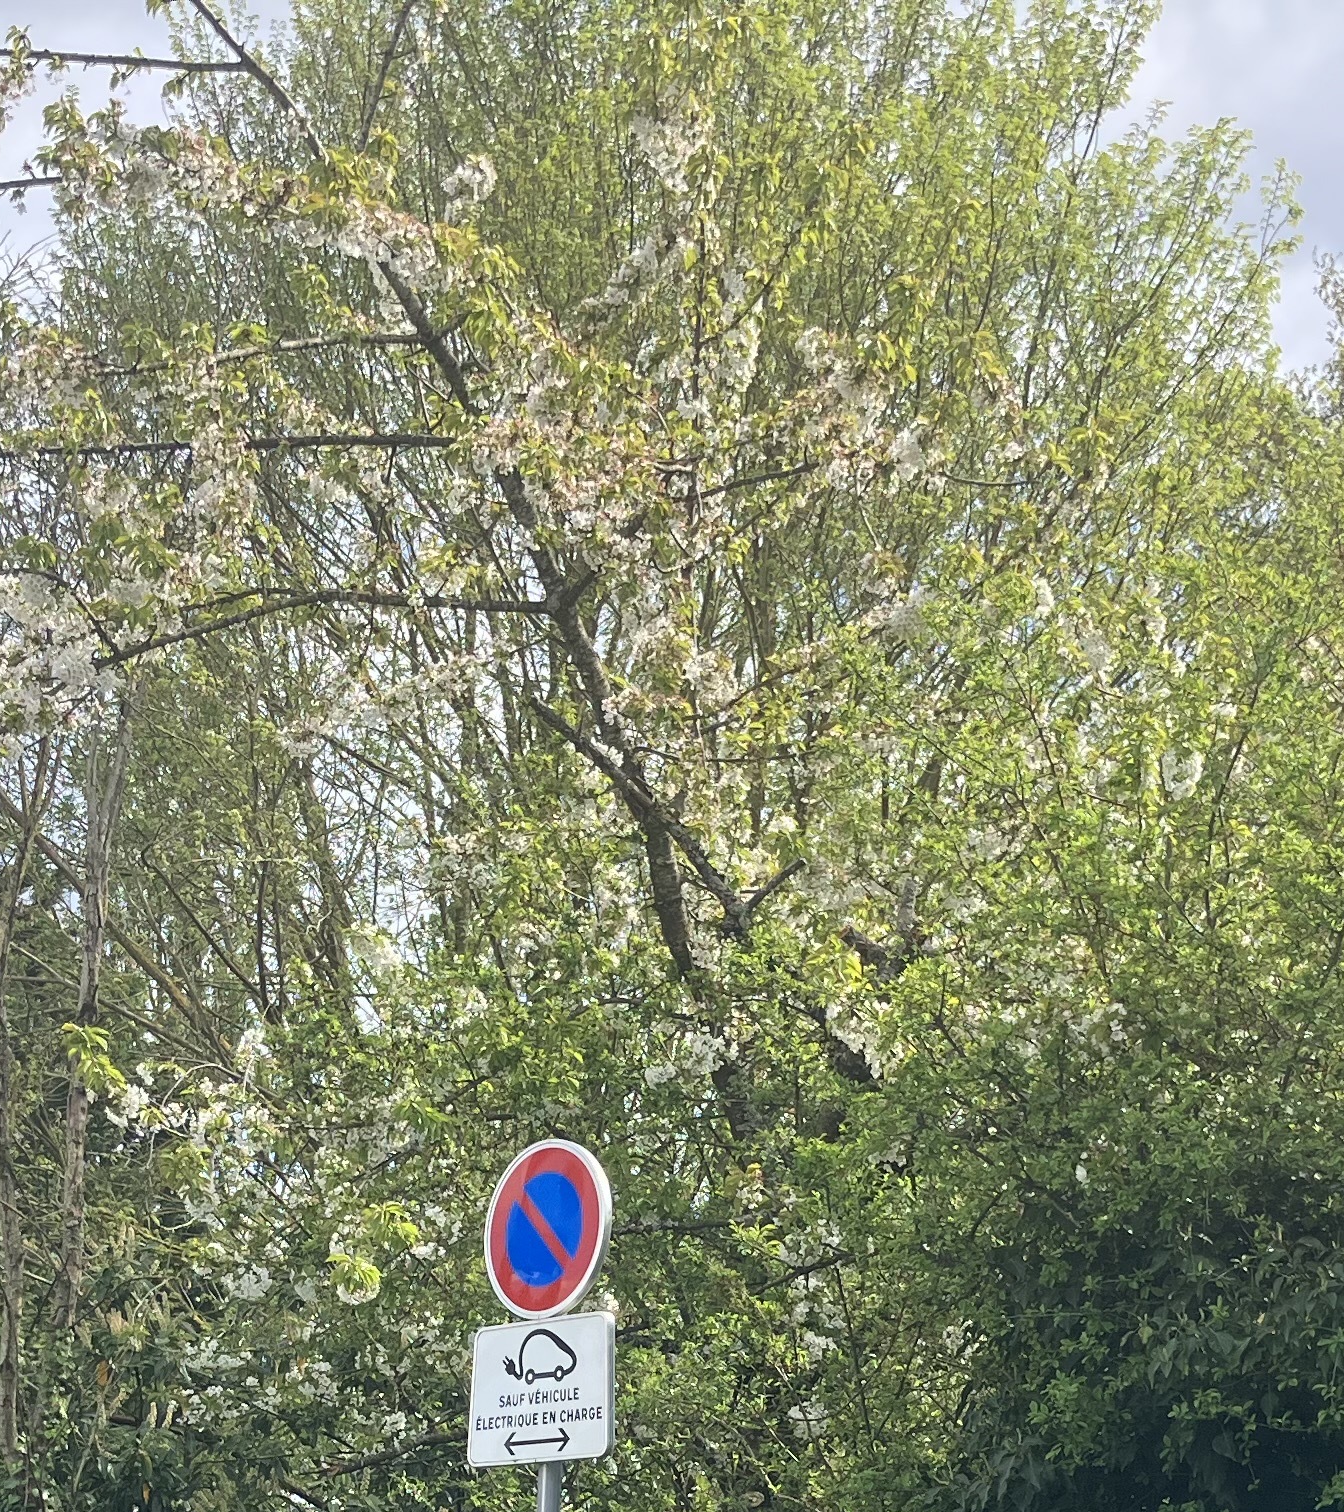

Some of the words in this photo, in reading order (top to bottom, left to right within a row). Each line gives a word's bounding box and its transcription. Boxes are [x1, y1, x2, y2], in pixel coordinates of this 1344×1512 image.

[499, 1393, 526, 1408] SAUF
[528, 1387, 580, 1405] VÉHICULE
[476, 1412, 539, 1431] ÉLECTRIQUE
[542, 1411, 557, 1425] EN
[560, 1406, 603, 1423] CHARGE
